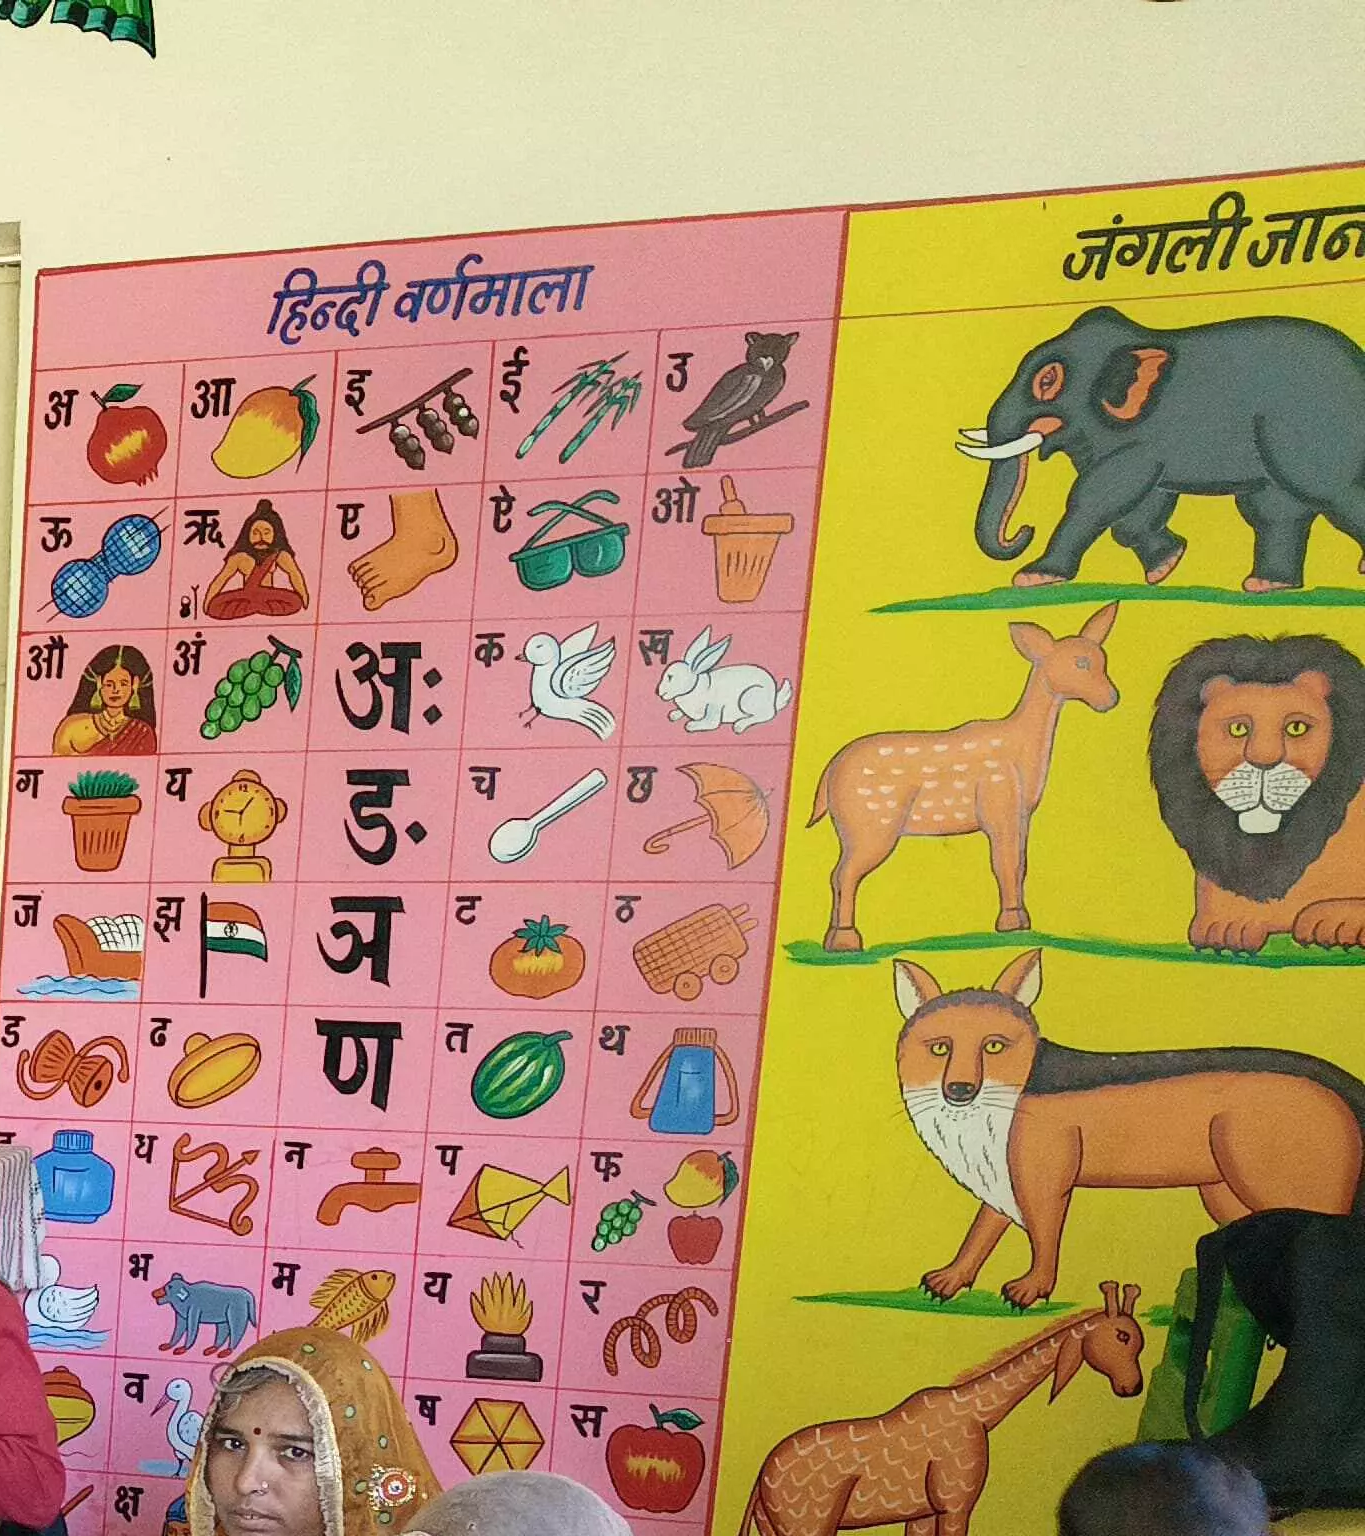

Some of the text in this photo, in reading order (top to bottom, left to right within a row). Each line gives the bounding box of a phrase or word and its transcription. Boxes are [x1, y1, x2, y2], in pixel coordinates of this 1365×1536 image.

[1063, 191, 1250, 280] जंगली
[267, 254, 593, 344] हिन्दी वर्णमाला
[500, 347, 527, 412] ई
[667, 353, 693, 394] उ
[45, 389, 78, 430] अ
[191, 378, 235, 418] आ
[345, 370, 371, 417] इ
[490, 486, 516, 532] ऐ
[652, 478, 699, 523] ओ
[40, 515, 73, 552] ऊ
[184, 510, 224, 550] ऋ
[337, 504, 364, 540] ए
[27, 635, 68, 681] औ
[173, 632, 206, 676] अं
[475, 633, 506, 666] क
[639, 628, 673, 666] ख
[335, 640, 442, 735] अः
[17, 769, 43, 801] ग
[165, 769, 193, 801] घ
[469, 766, 498, 800] च
[627, 765, 655, 802] छ
[13, 895, 41, 928] ज
[155, 896, 184, 942] झ
[454, 896, 482, 926] ट
[615, 895, 642, 923] ठ
[317, 895, 404, 987] ञ
[0, 1016, 26, 1048] ड
[148, 1017, 171, 1048] ढ
[445, 1021, 474, 1054] त
[599, 1024, 630, 1057] थ
[315, 1017, 402, 1111] ण
[284, 1139, 314, 1170] न
[436, 1145, 462, 1177] प
[590, 1151, 623, 1182] फ
[128, 1254, 153, 1282] भ
[273, 1262, 300, 1296] म
[424, 1271, 453, 1305] य
[579, 1280, 608, 1313] र
[123, 1373, 149, 1404] व
[415, 1394, 441, 1426] ष
[569, 1403, 607, 1439] स
[113, 1486, 144, 1522] क्ष
